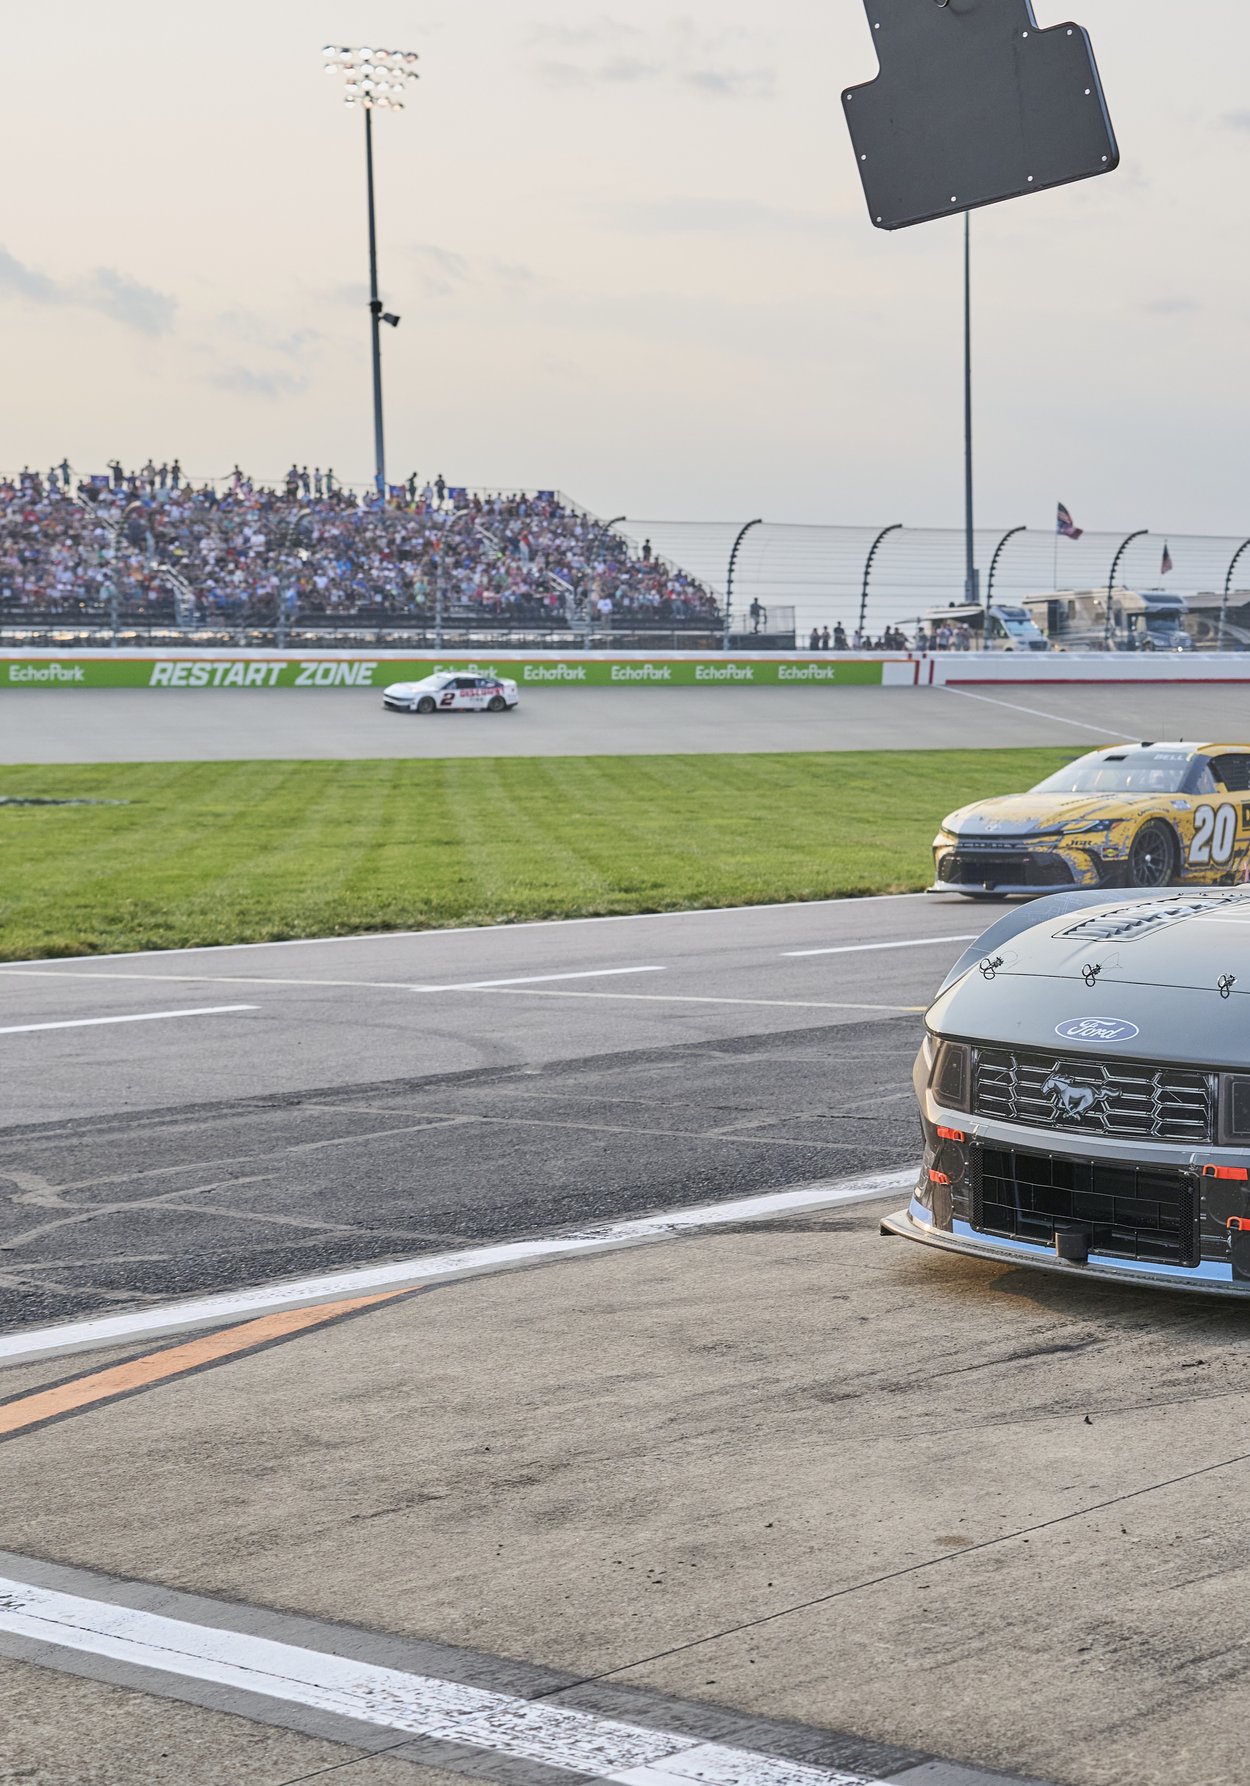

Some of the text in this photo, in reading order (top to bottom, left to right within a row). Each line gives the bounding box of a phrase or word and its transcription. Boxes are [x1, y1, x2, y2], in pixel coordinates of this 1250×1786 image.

[8, 663, 85, 682] EchoPark
[149, 661, 378, 686] RESTART ZONE
[523, 664, 587, 681] EchoPark
[611, 664, 672, 681] EchoPark
[695, 663, 754, 680] EchoPark
[778, 663, 834, 680] EchoPark
[440, 692, 456, 706] 2
[1188, 803, 1237, 865] 20
[1067, 1019, 1125, 1039] Ford
